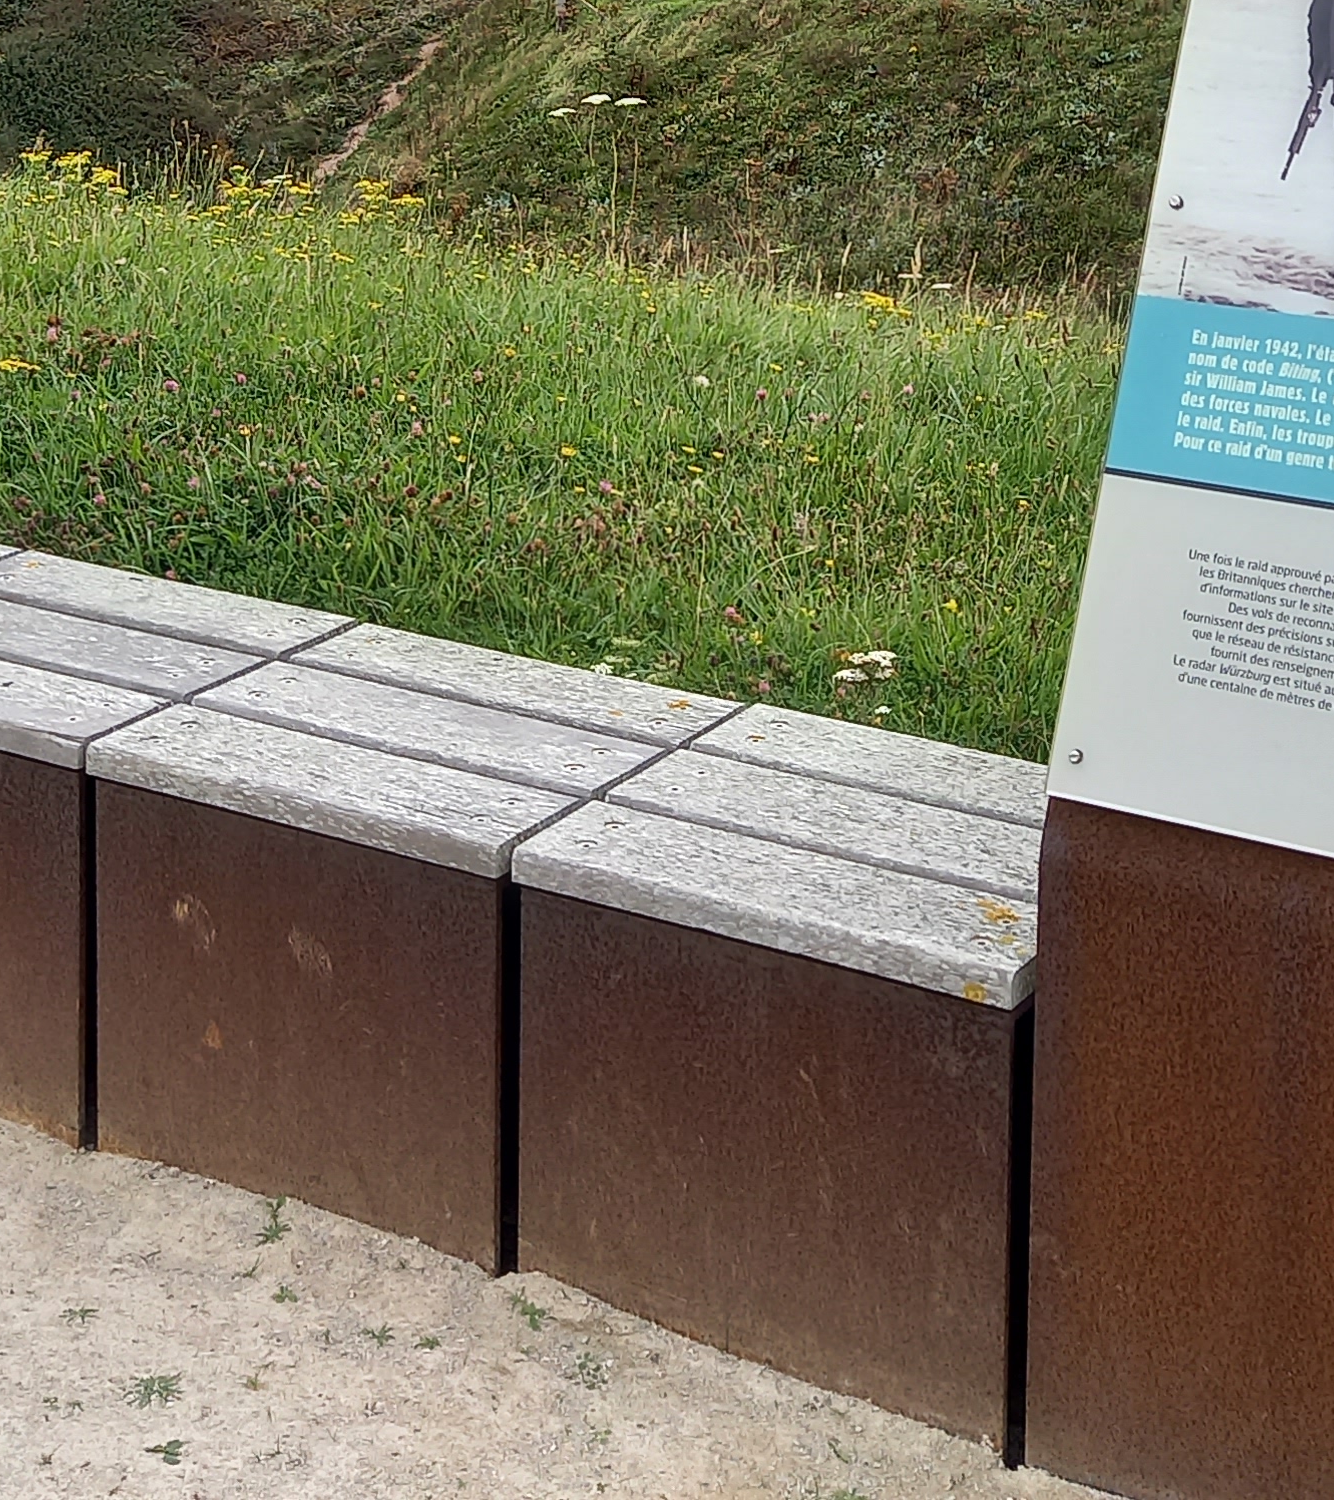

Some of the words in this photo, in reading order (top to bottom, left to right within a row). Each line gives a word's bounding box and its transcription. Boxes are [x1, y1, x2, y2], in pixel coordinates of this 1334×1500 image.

[1191, 328, 1208, 346] En
[1211, 331, 1260, 353] janvier
[1265, 338, 1303, 360] 1942,
[1187, 352, 1218, 368] nom
[1220, 354, 1239, 371] de
[1242, 358, 1274, 376] code
[1278, 362, 1322, 384] Biting,
[1188, 548, 1210, 563] Une
[1212, 552, 1233, 567] fois
[1234, 556, 1245, 569] le
[1247, 560, 1269, 573] raid
[1270, 564, 1322, 582] approuvé
